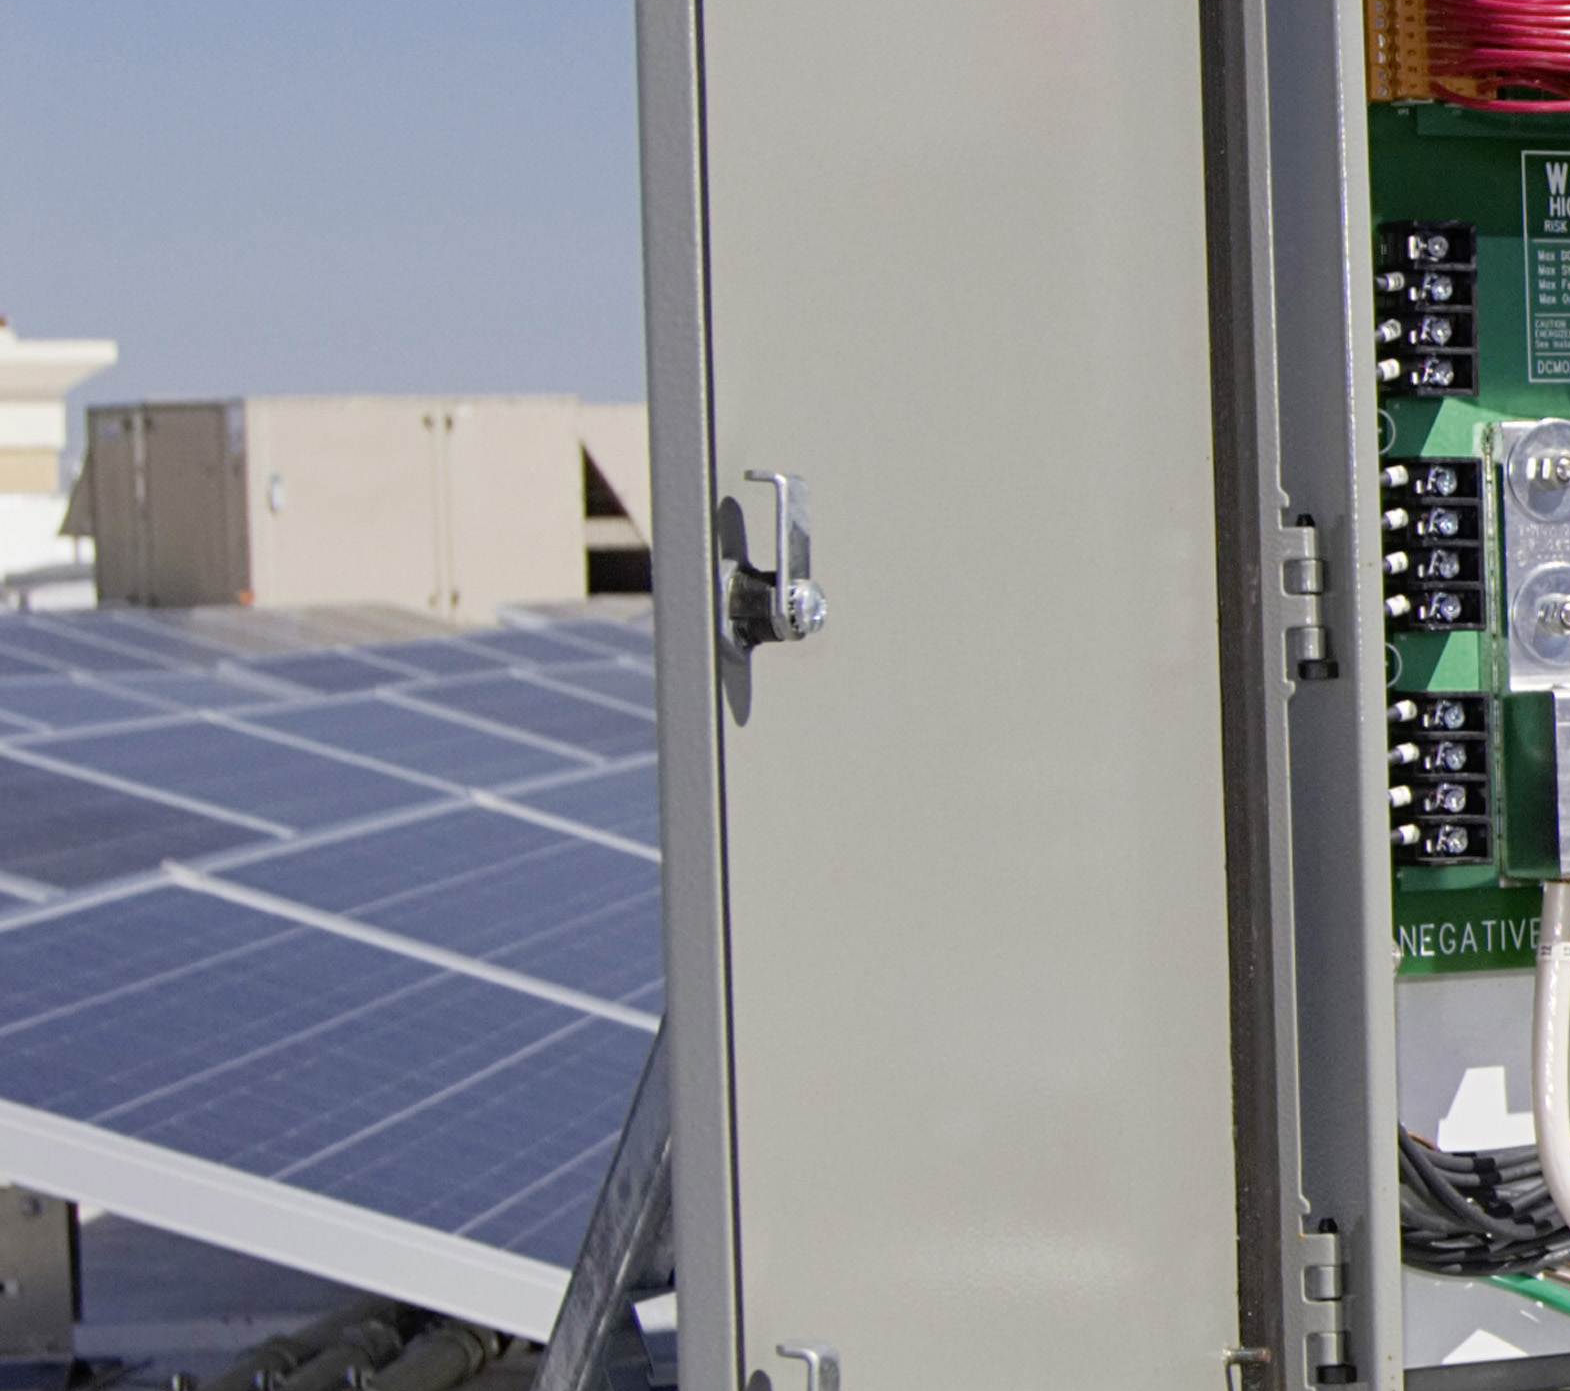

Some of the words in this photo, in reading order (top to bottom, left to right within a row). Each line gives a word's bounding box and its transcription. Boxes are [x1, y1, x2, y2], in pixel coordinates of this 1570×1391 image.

[1543, 219, 1568, 233] RISK
[1537, 250, 1556, 261] Max
[1537, 265, 1556, 276] Max
[1538, 279, 1556, 290] Max
[1539, 294, 1557, 304] Max
[1534, 320, 1567, 329] CAUTION
[1399, 917, 1541, 957] NEGATIVE
